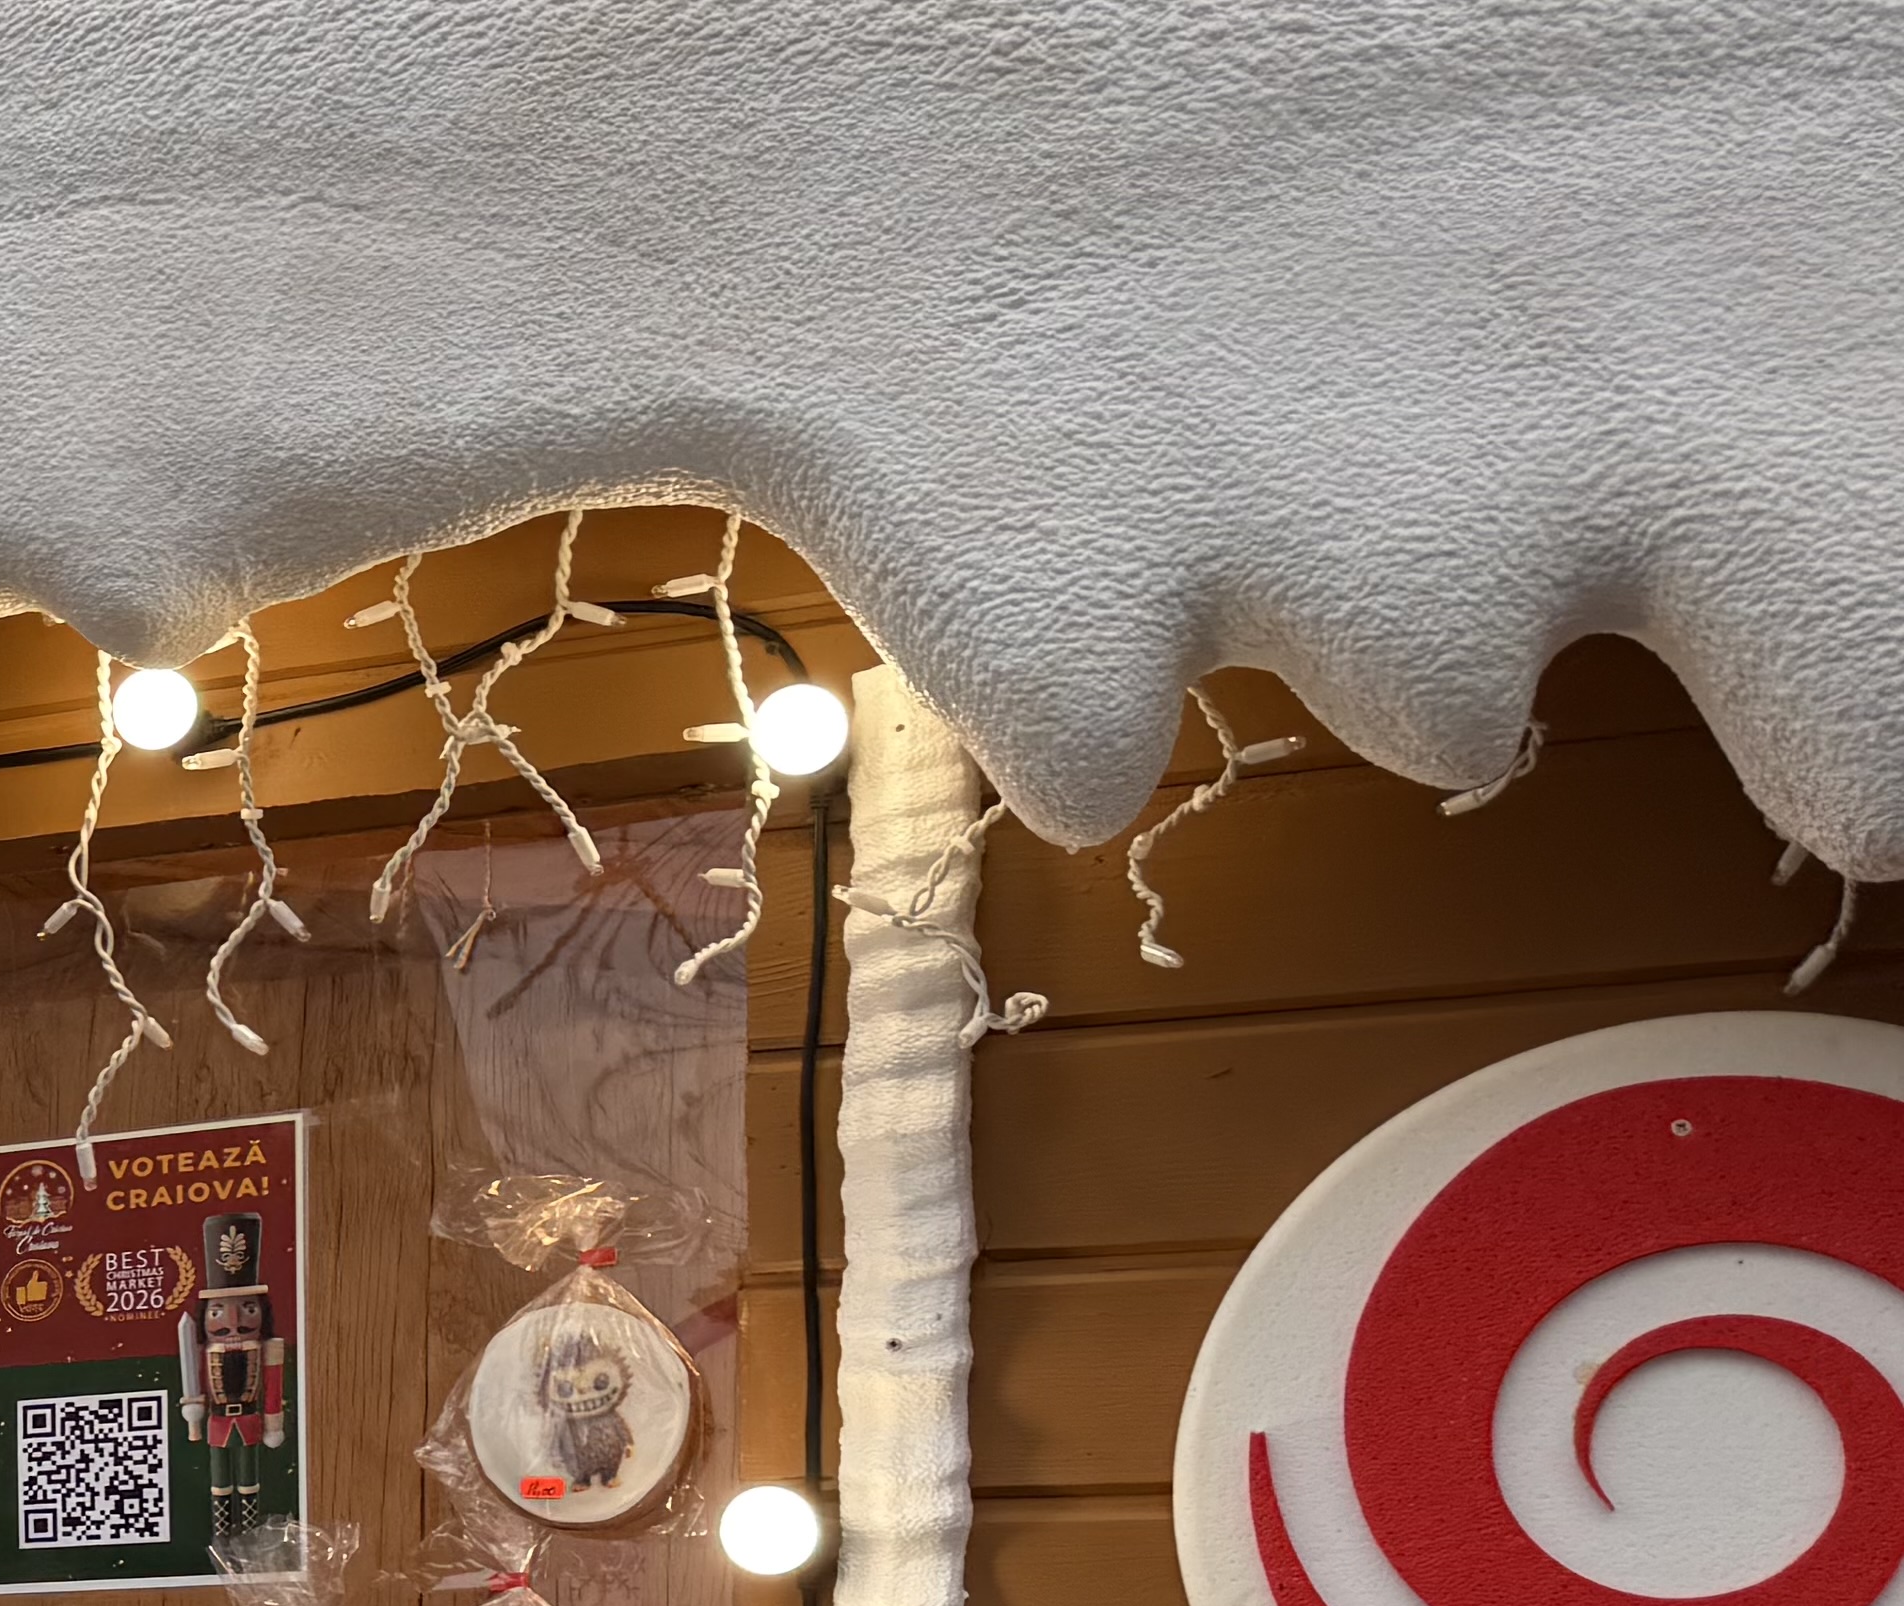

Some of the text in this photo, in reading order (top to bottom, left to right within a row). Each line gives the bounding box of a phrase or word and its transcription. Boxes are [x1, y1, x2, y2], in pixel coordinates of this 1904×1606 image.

[108, 1139, 267, 1180] VOTEAZĂ
[105, 1176, 270, 1212] CRAIOVA!
[105, 1248, 165, 1272] BEST
[106, 1275, 165, 1292] MARKET
[106, 1288, 165, 1312] 2026
